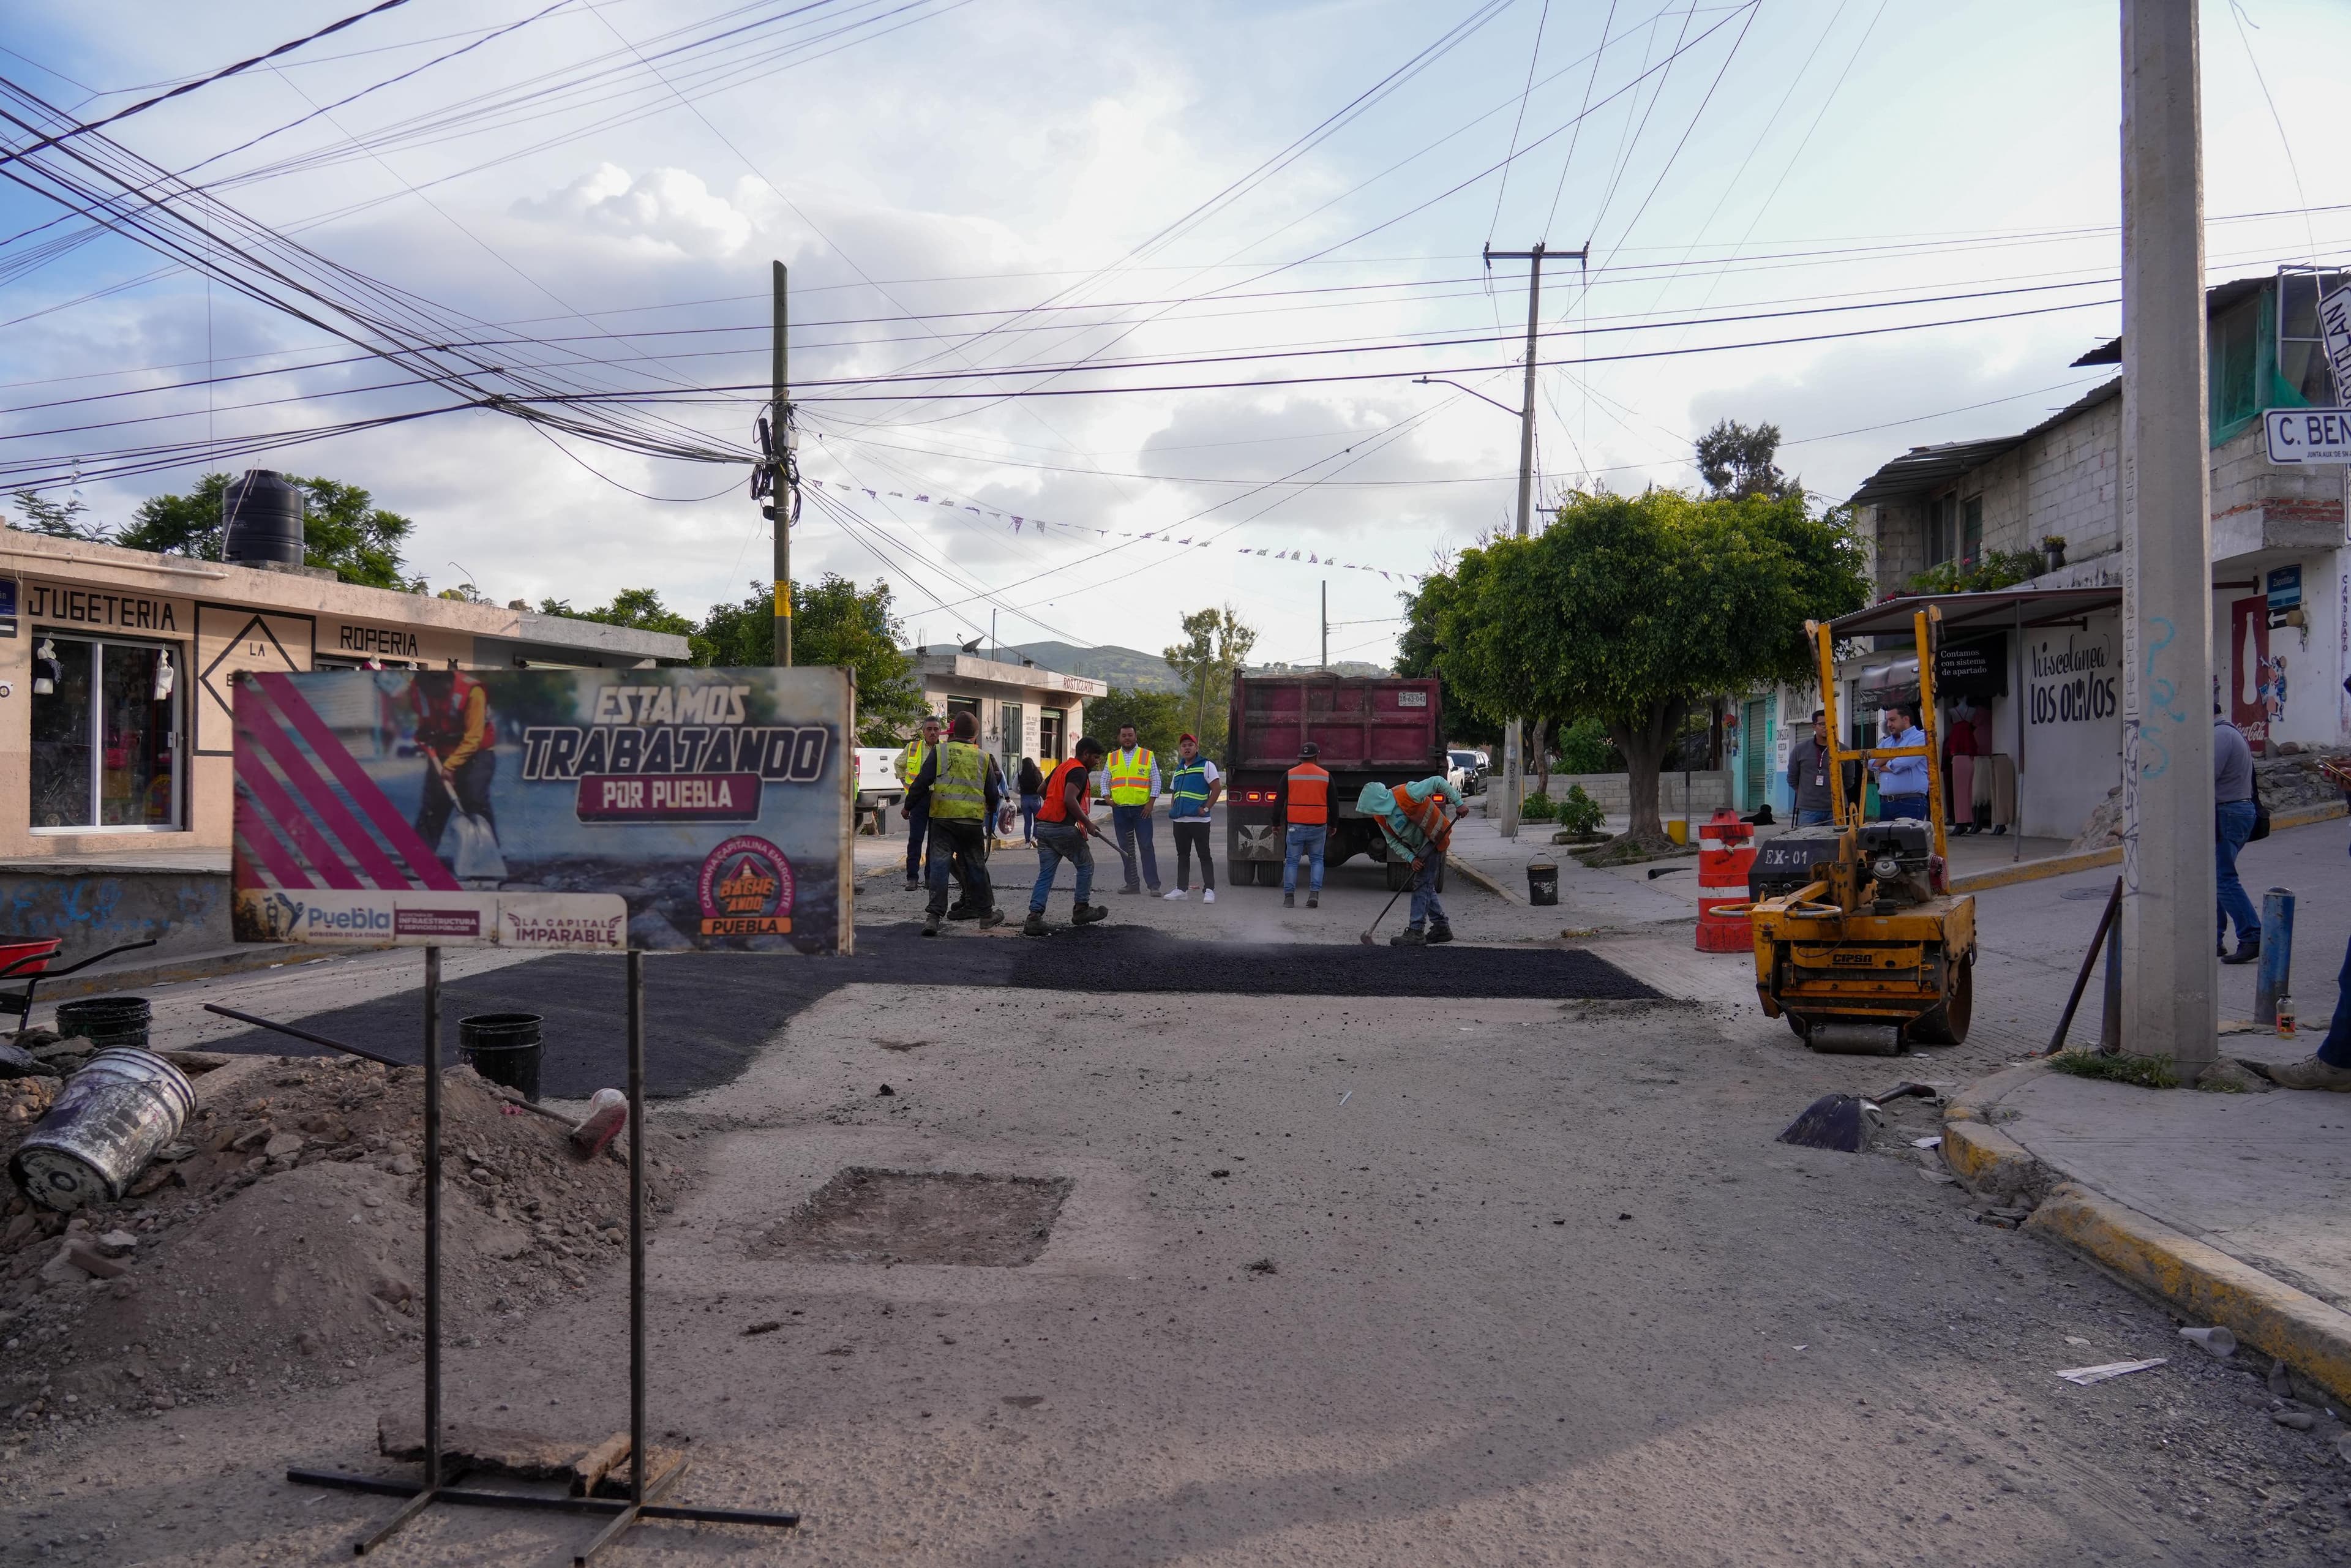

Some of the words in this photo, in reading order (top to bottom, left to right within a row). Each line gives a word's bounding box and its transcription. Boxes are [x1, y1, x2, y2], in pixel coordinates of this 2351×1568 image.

[2324, 302, 2351, 407] TITLAN
[2279, 417, 2300, 446] C.
[28, 587, 176, 631] JUGETERIA
[250, 642, 265, 656] LA
[340, 625, 418, 656] ROPERIA
[1940, 650, 1979, 658] Contamos
[1952, 666, 1987, 677] apartado
[1063, 677, 1093, 692] ROSTICERIA
[593, 685, 751, 725] ESTAMOS
[2031, 684, 2057, 725] LOS
[522, 727, 828, 782] TRABAJANDO
[602, 781, 643, 809] POR
[652, 779, 733, 808] PUEBLA
[1764, 849, 1807, 865] EX-01
[767, 849, 792, 909] EMERGENTE
[308, 907, 391, 929] Puebla
[546, 918, 607, 928] CAPITAL
[712, 920, 778, 933] PUEBLA
[516, 928, 617, 943] IMPARABLE
